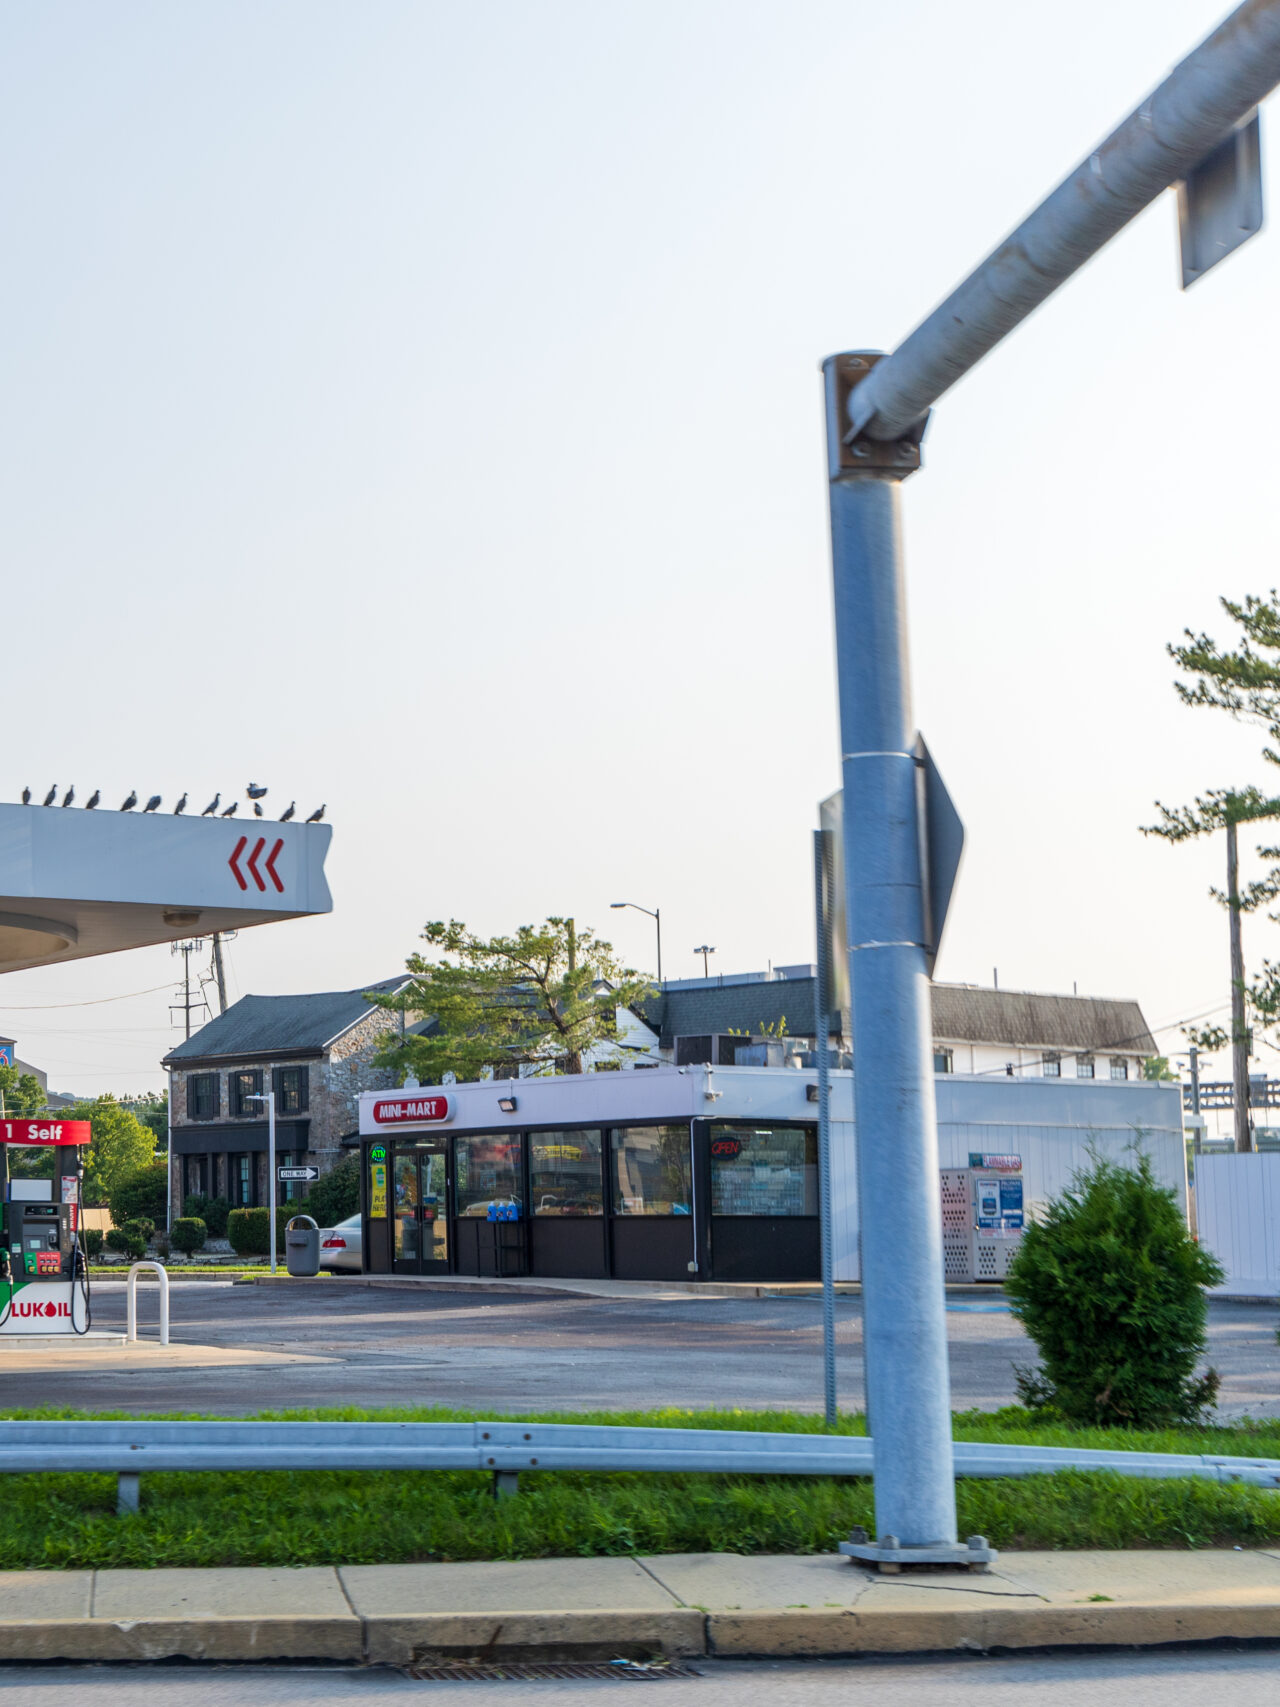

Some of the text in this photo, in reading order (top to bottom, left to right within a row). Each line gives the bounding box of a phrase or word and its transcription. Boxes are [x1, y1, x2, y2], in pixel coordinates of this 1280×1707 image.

[379, 1101, 437, 1118] MINI-MART
[5, 1123, 63, 1140] 1 Self
[711, 1141, 739, 1154] OPEN
[11, 1301, 71, 1318] LUKOIL
